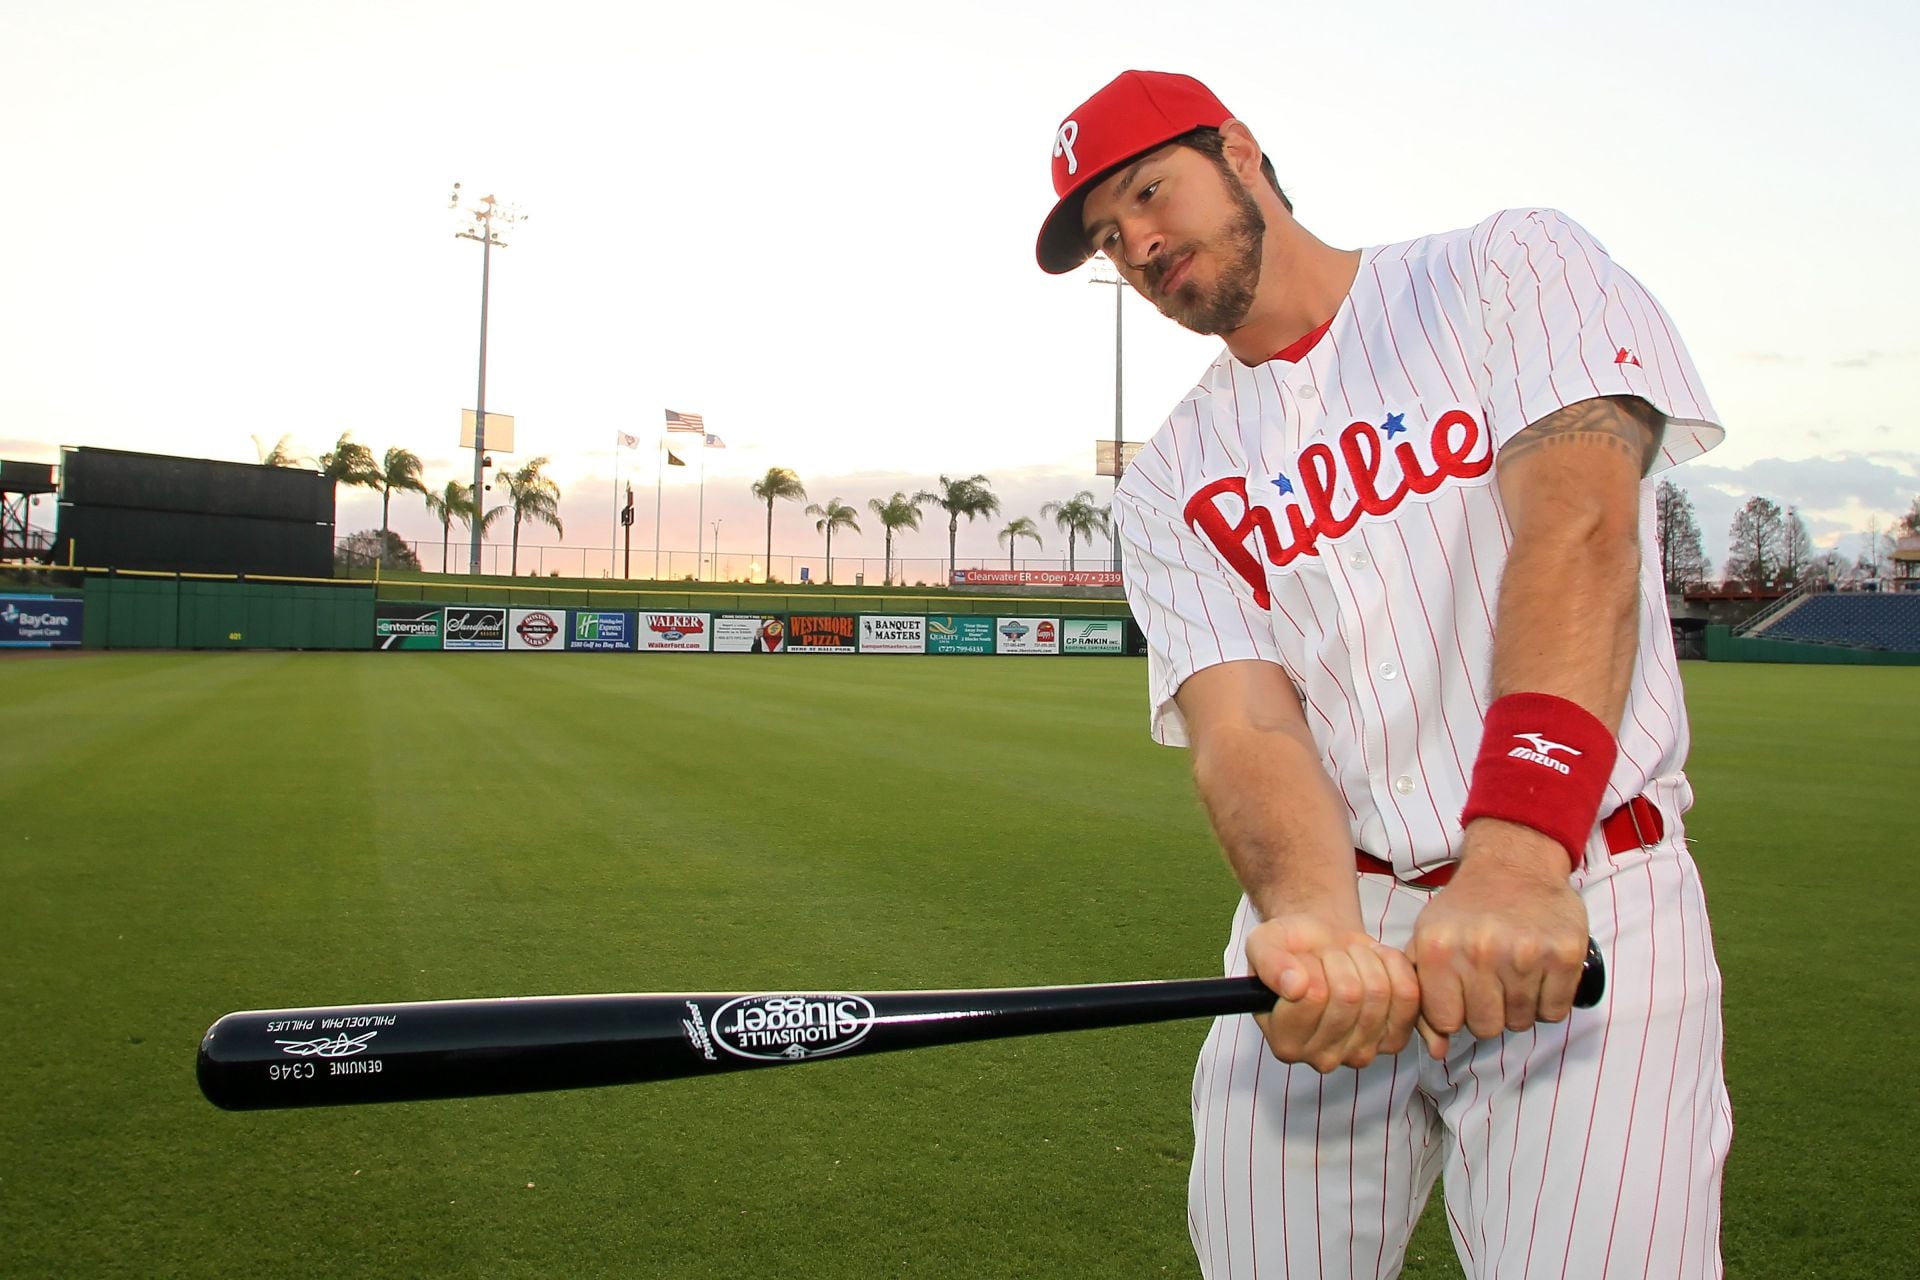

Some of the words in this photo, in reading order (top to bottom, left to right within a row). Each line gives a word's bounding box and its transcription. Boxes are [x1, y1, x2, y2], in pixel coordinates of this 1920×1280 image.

[1053, 120, 1079, 175] P
[1183, 408, 1493, 611] Phillie
[967, 571, 1017, 582] Clearwater
[1019, 572, 1031, 582] ER
[1041, 572, 1067, 583] Open
[1068, 572, 1089, 582] 24/7
[1098, 572, 1121, 583] 2339
[19, 613, 69, 628] BayCare
[525, 614, 551, 624] BOSTON
[646, 615, 699, 627] WALKER
[875, 620, 921, 630] BANQUET
[44, 628, 61, 636] Care
[381, 622, 437, 634] enterprise
[790, 616, 853, 638] WESTSHORE
[523, 635, 551, 646] MARKET
[803, 634, 841, 646] PIZZA
[875, 631, 921, 640] MASTERS
[929, 633, 959, 641] QUALITY
[1507, 746, 1570, 775] MIZUNO
[321, 1014, 396, 1030] PHILADELPHIA
[731, 998, 859, 1039] Slugger
[266, 1019, 315, 1032] PHILLIES
[738, 1026, 828, 1048] LOUISVILLE
[269, 1062, 315, 1081] C346
[330, 1060, 383, 1076] GENUINE
